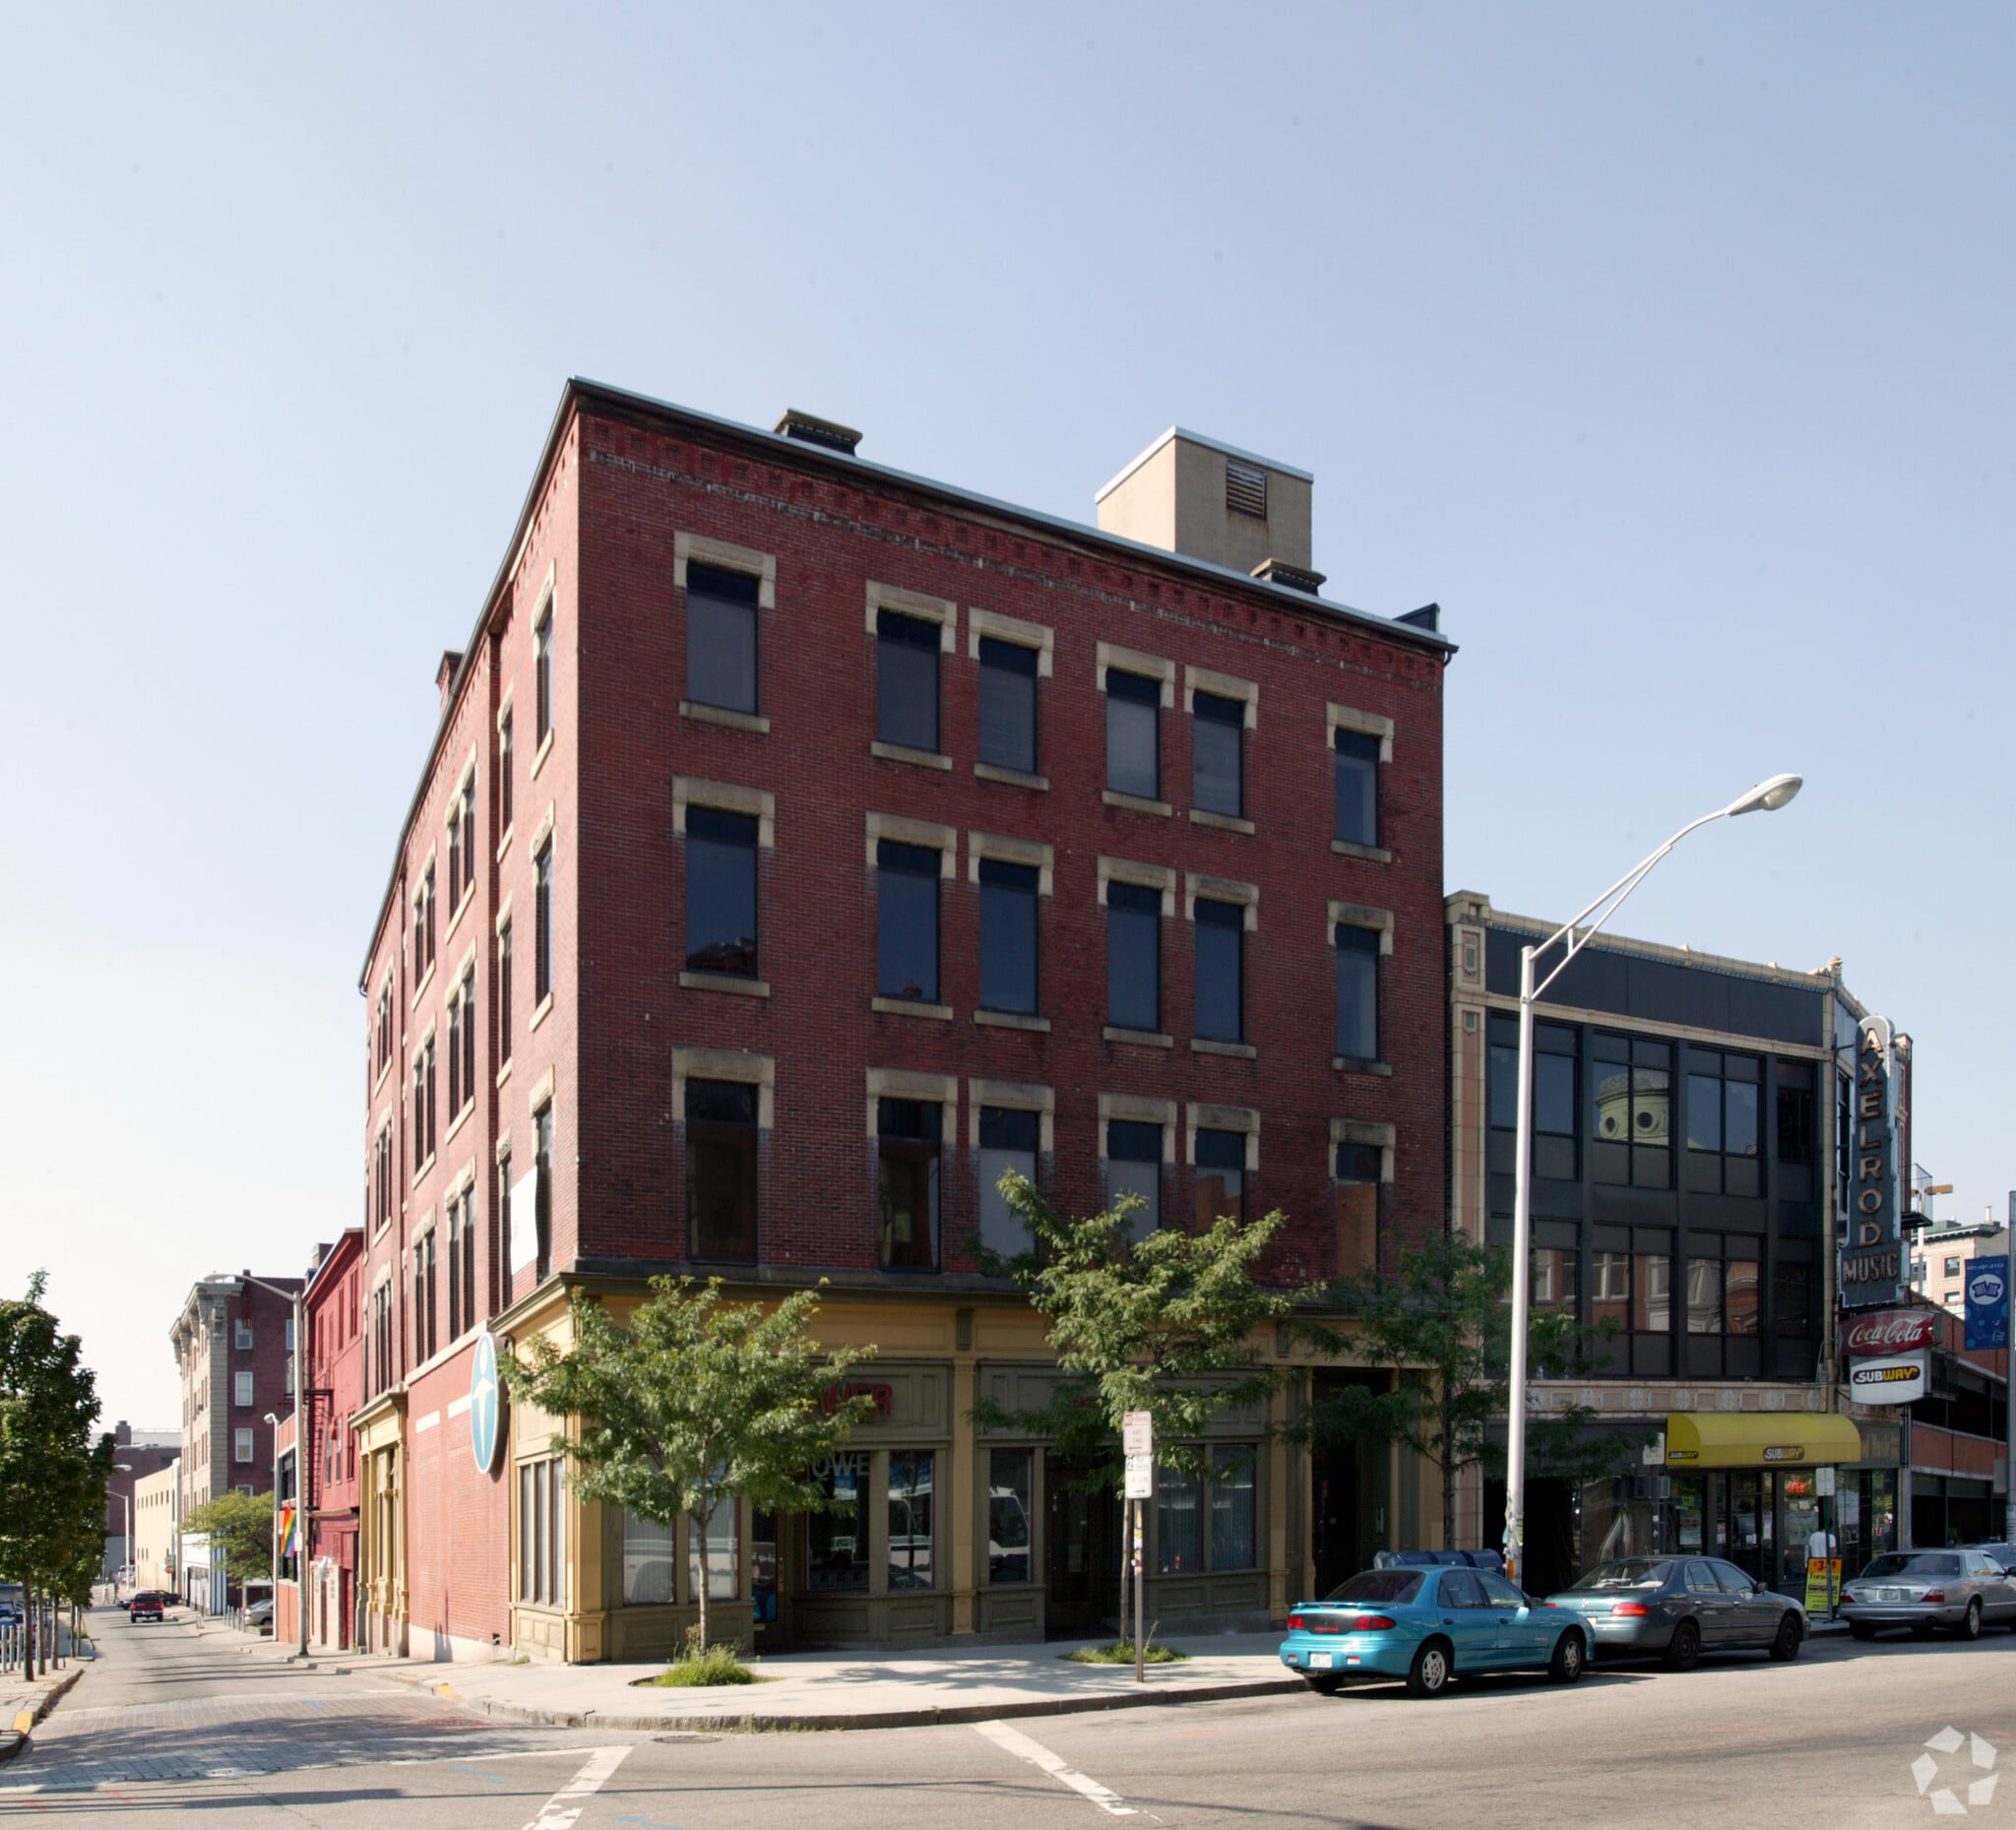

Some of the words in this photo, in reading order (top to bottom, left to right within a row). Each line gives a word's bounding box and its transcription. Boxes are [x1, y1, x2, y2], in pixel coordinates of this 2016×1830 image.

[1858, 1027, 1884, 1247] AXELROD
[1842, 1252, 1899, 1285] MUSIC
[1855, 1366, 1919, 1383] SUBWAY
[1764, 1447, 1802, 1460] SUBWAY
